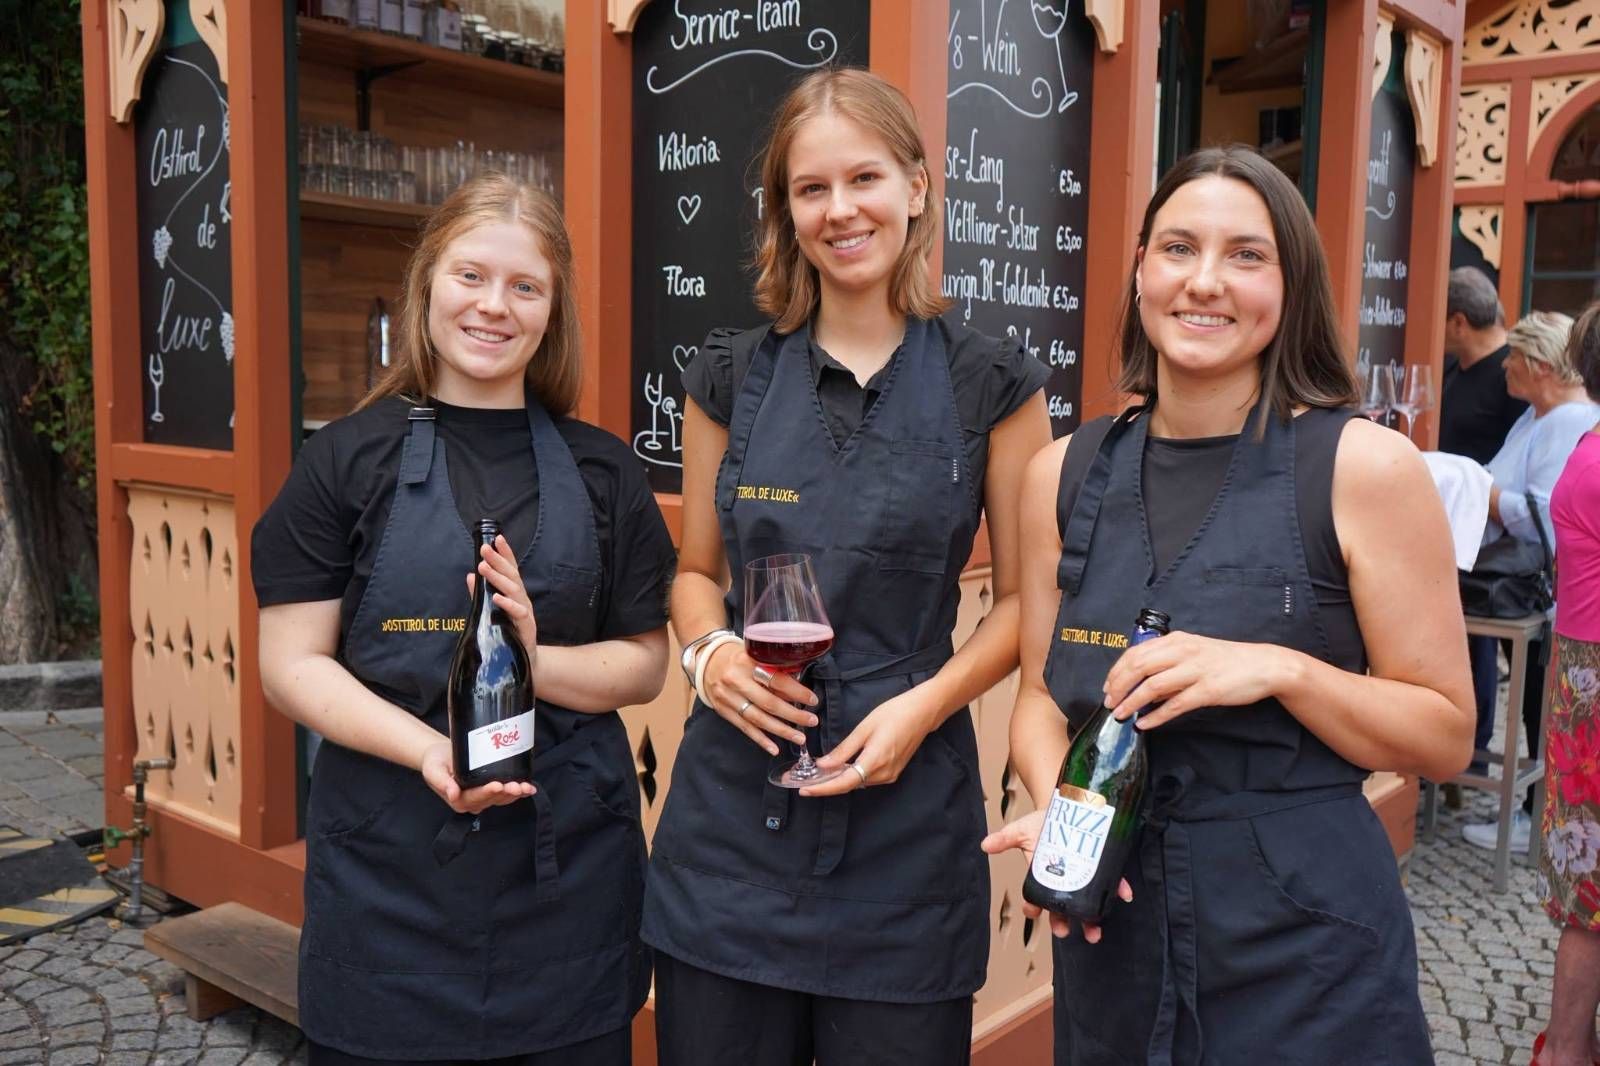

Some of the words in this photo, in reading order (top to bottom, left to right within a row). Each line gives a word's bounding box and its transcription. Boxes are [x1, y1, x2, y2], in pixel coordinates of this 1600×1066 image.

[151, 124, 205, 186] Osttirol
[658, 131, 721, 172] Viktoria
[1059, 169, 1082, 197] €5,00
[197, 203, 216, 249] de
[1056, 225, 1082, 253] €5,00
[662, 265, 706, 297] Flora
[1053, 285, 1079, 312] €5,00
[157, 277, 212, 353] luxe
[1049, 339, 1076, 370] €6,00
[1048, 395, 1072, 420] €6,00
[758, 487, 770, 500] DE
[771, 488, 800, 504] LUXE«
[382, 618, 426, 632] »OSTTIROL
[428, 618, 440, 631] DE
[442, 618, 466, 631] LUXE
[1090, 631, 1102, 645] DE
[491, 724, 520, 750] Rosé
